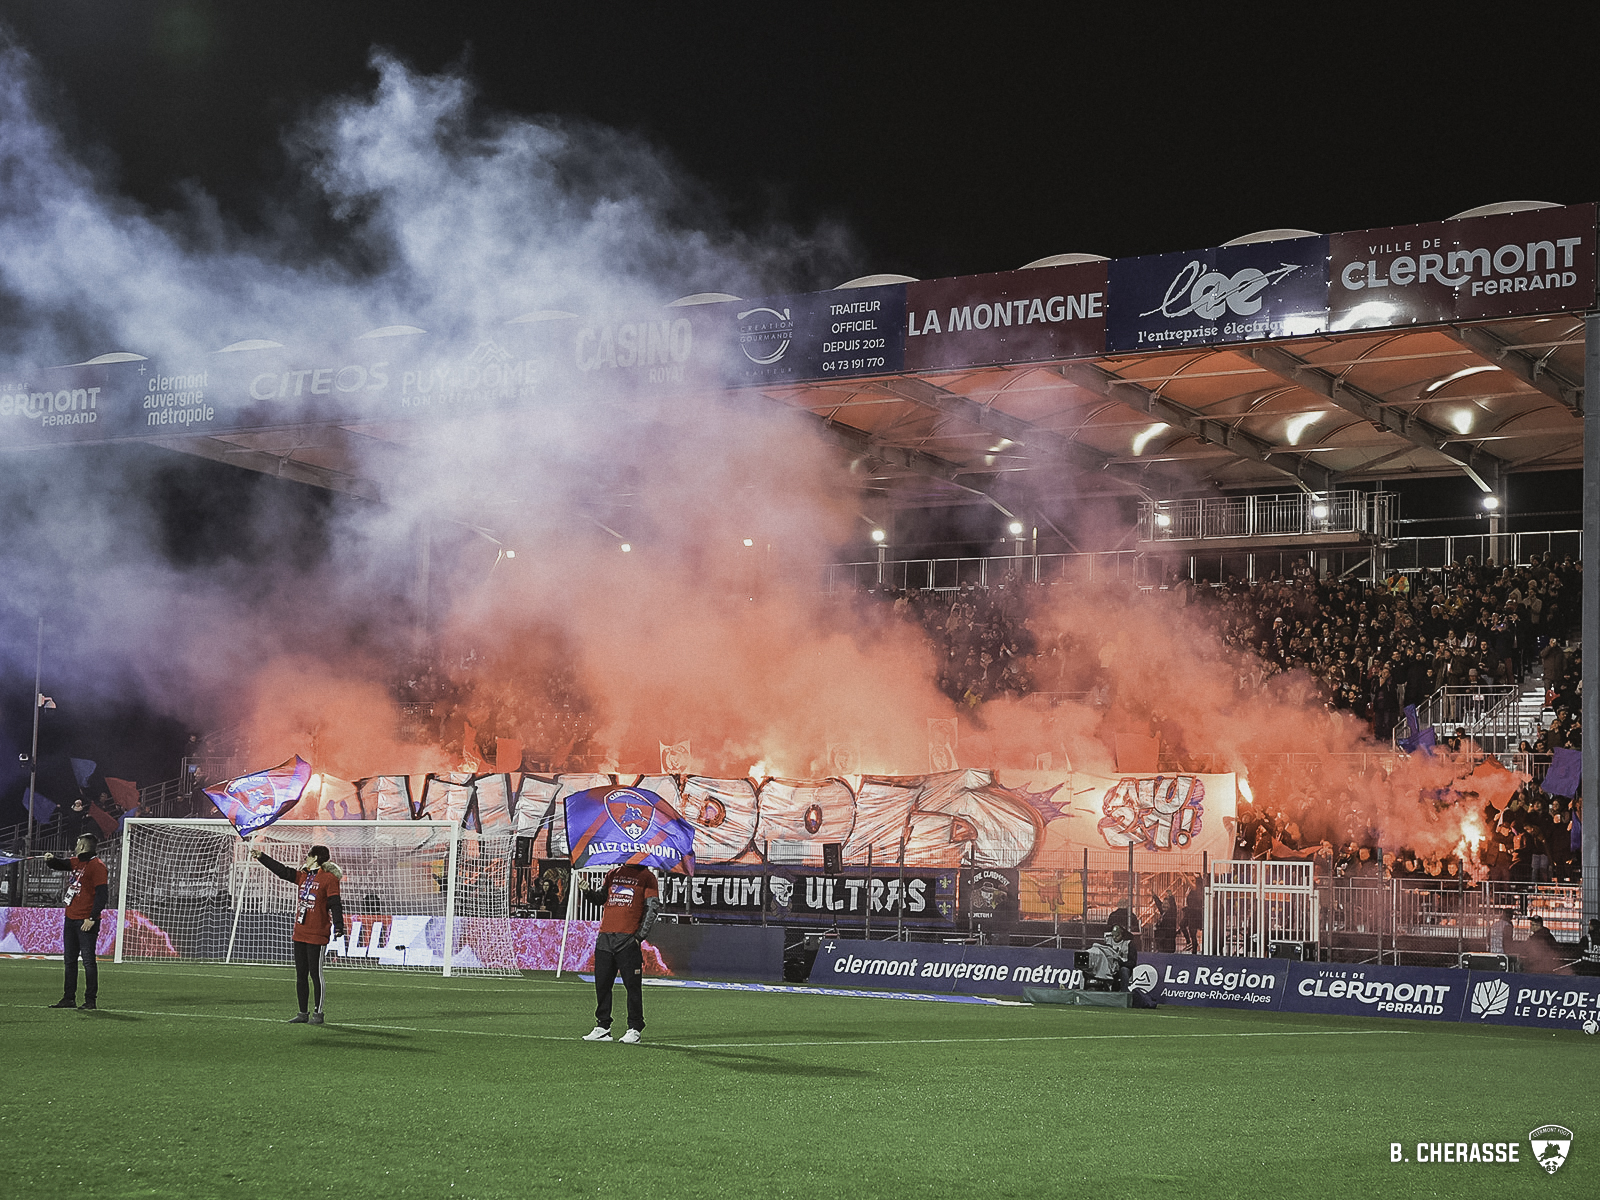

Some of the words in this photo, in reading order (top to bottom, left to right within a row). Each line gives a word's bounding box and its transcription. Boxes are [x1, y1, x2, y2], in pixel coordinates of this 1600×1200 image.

[1369, 241, 1411, 255] VILLE
[1422, 238, 1441, 249] DE
[830, 301, 881, 316] TRAITEUR
[909, 310, 942, 336] LA
[948, 292, 1104, 332] MONTAGNE
[831, 320, 877, 333] OFFICIEL
[1137, 326, 1218, 343] l'entreprise
[575, 318, 693, 371] CASINO
[739, 332, 793, 343] GOURMANDE
[822, 340, 860, 353] DEPUIS
[862, 338, 885, 349] 2012
[822, 361, 835, 371] 04
[838, 359, 849, 370] 73
[851, 358, 864, 369] 191
[867, 356, 885, 367] 770
[148, 370, 208, 392] clermont
[250, 361, 390, 401] CITEOS
[143, 391, 204, 409] auvergne
[147, 404, 215, 426] métropole
[588, 843, 619, 856] ALLEZ
[621, 843, 675, 860] CLERMONT
[805, 876, 927, 913] ULTRAS
[834, 955, 918, 977] clermont
[920, 962, 1009, 982] auvergne
[1319, 970, 1347, 979] VILLE
[1352, 972, 1365, 980] DE
[1163, 965, 1190, 984] La
[1194, 966, 1275, 990] Région
[1160, 987, 1271, 1004] Auvergne-Rhône-Alpes
[1516, 988, 1600, 1008] PUY-DE-
[1514, 1005, 1531, 1017] LE
[1537, 1005, 1600, 1021] DÉPART
